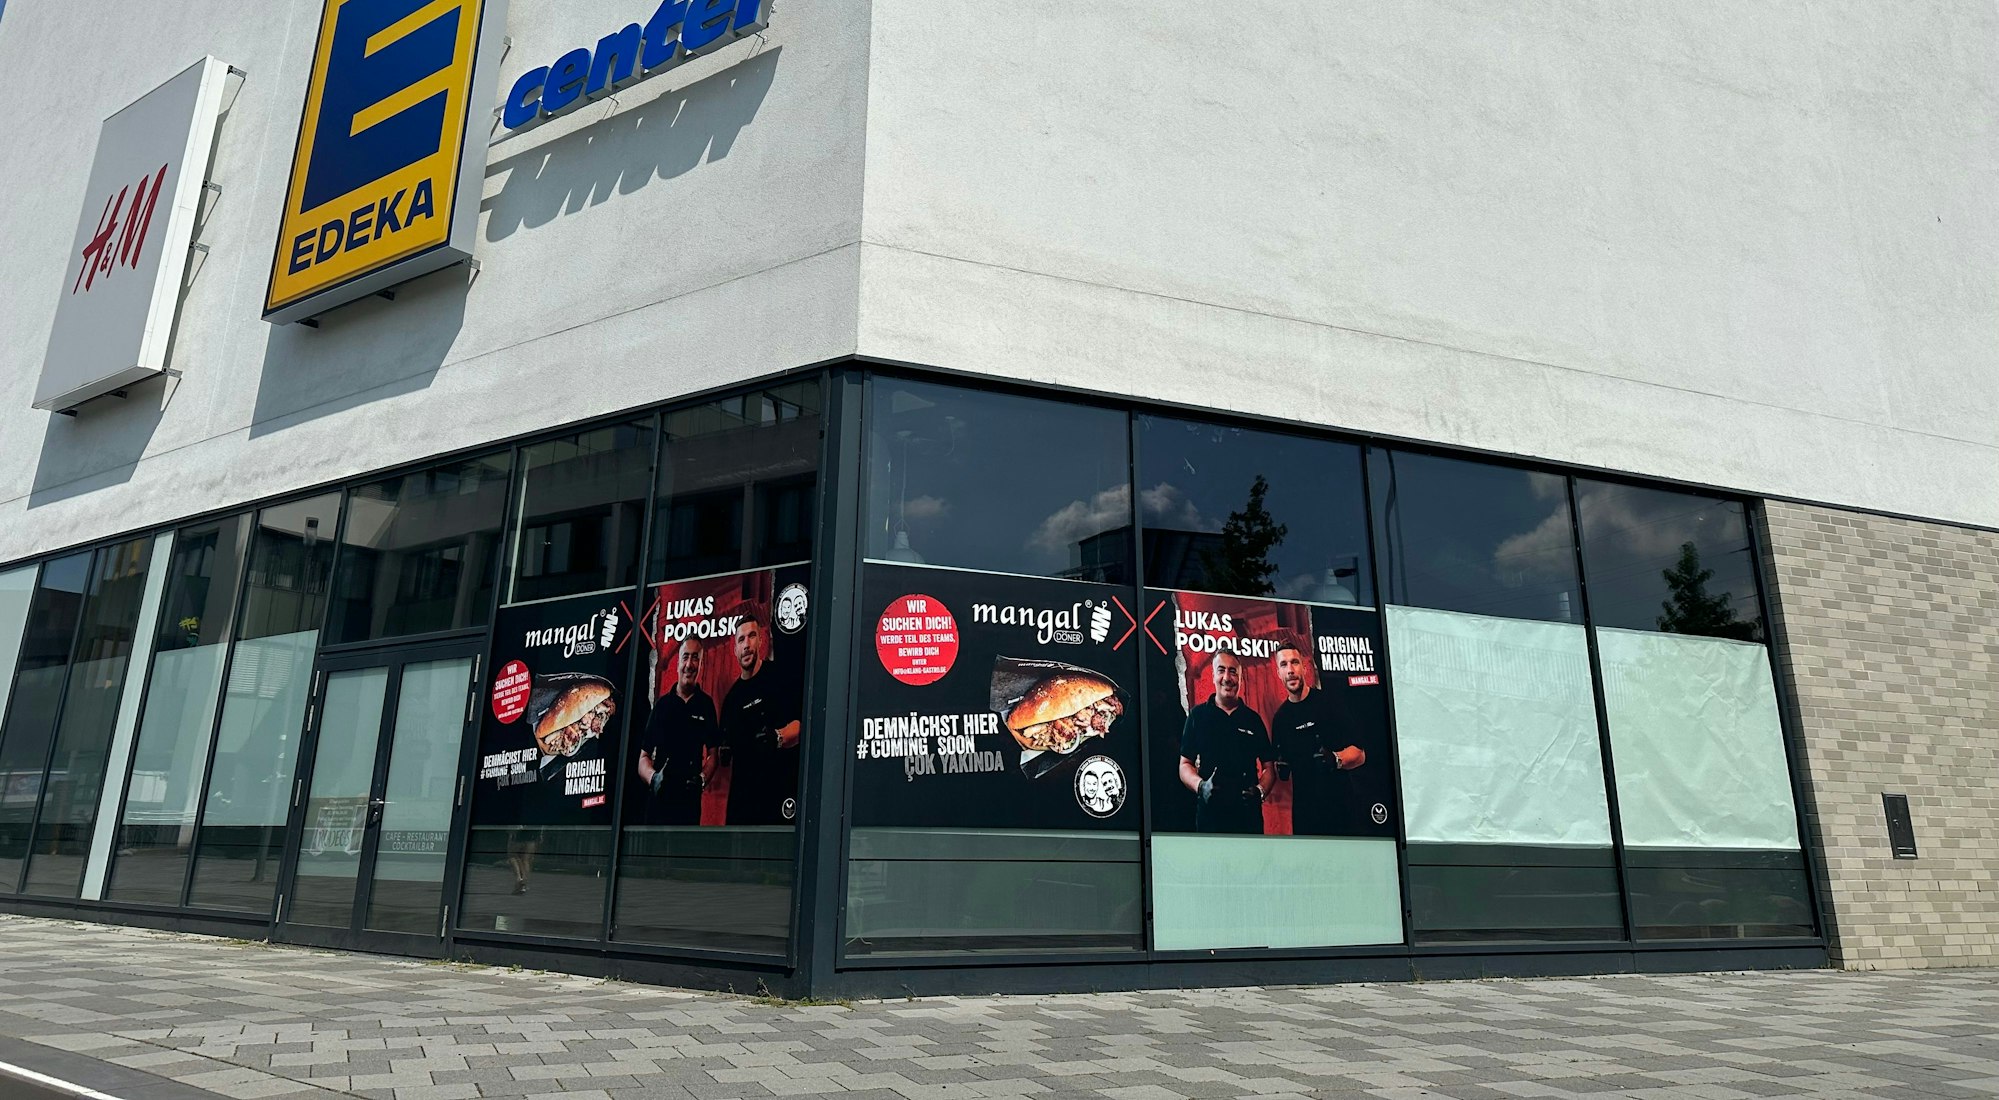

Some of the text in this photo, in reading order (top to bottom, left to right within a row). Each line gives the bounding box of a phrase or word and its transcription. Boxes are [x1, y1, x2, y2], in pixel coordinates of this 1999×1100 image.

[73, 163, 168, 295] H&M
[288, 177, 434, 276] EDEKA
[666, 596, 714, 620] LUKAS
[907, 600, 927, 613] WIR
[664, 615, 743, 643] PODOLSK
[882, 616, 952, 631] SUCHEN DICH!
[972, 603, 1082, 644] mangal
[1176, 610, 1233, 632] LUKAS
[525, 614, 598, 658] mangal
[880, 635, 903, 644] WERDE
[904, 634, 918, 643] TEIL
[919, 634, 931, 643] DES
[1318, 636, 1373, 654] ORIGINAL
[898, 647, 939, 657] BEWIRB DICH
[1321, 654, 1374, 671] MANGAL!
[863, 712, 999, 740] DEMNÄCHST HIER
[522, 748, 538, 761] HIER
[937, 735, 975, 755] SOON
[566, 758, 606, 778] ORIGINAL
[904, 750, 1004, 782] ÇOK YAKINDA
[565, 775, 605, 795] MANGAL!
[392, 841, 434, 851] COCKTAILBAR
[406, 832, 448, 842] RESTAURANT
